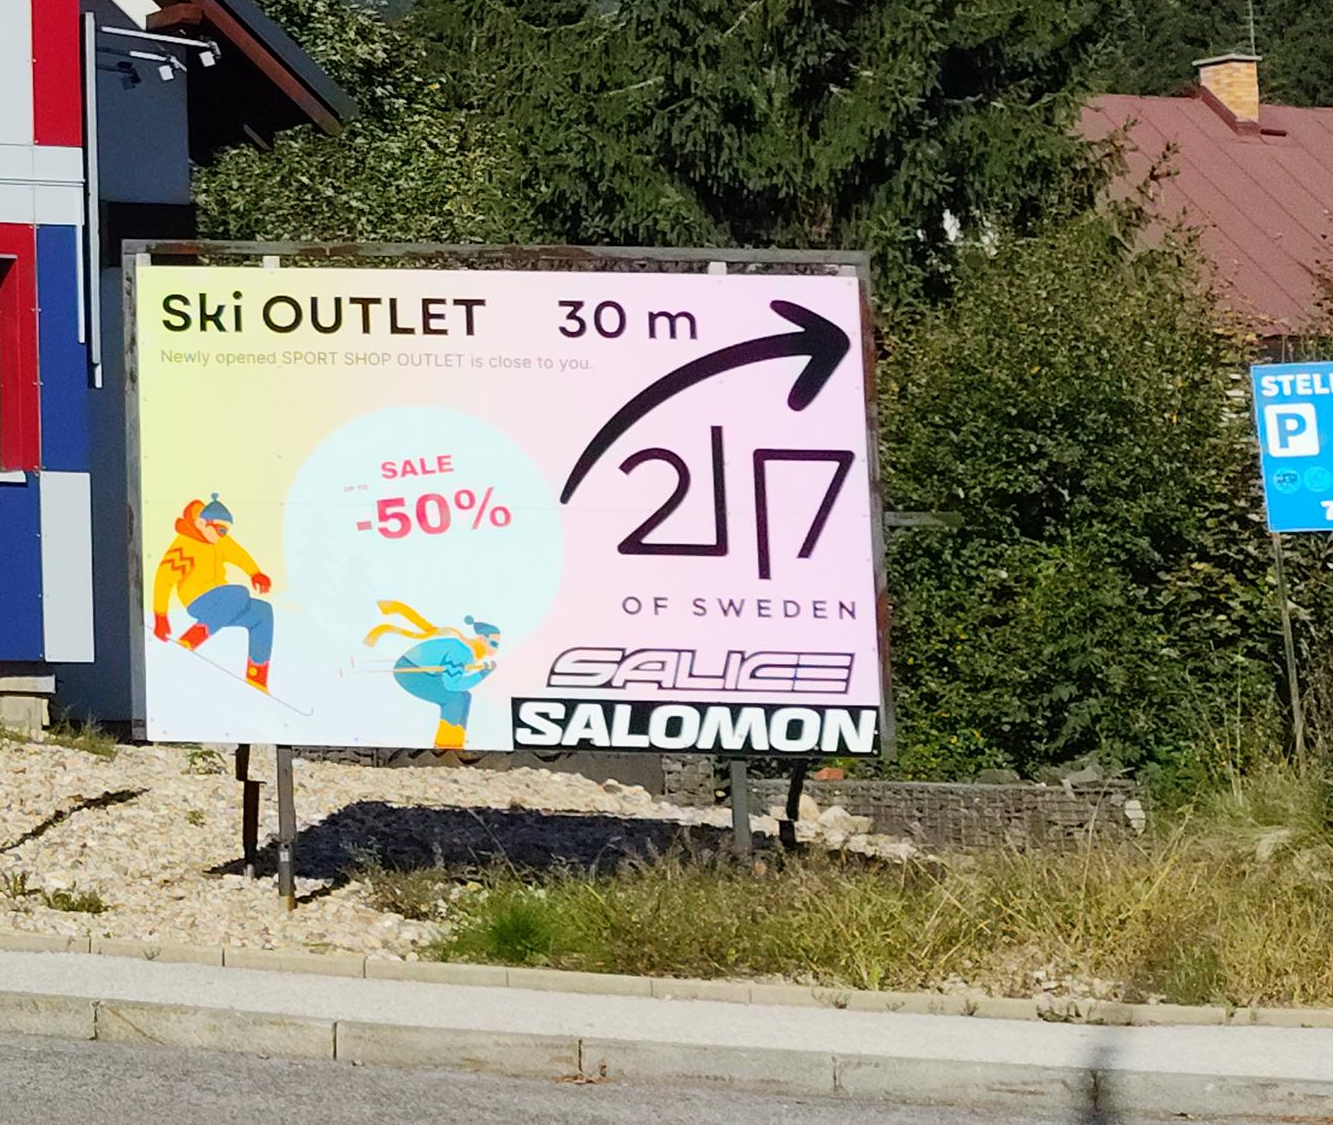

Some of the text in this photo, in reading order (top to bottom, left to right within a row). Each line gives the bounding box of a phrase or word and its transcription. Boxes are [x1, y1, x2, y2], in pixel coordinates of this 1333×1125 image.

[161, 290, 698, 340] Ski OUTLET 30 m
[160, 348, 594, 373] Newly opened SPORT SHOP OUTLET is close to you.
[1261, 373, 1333, 397] STEL
[1275, 412, 1307, 449] P
[381, 454, 454, 479] SALE
[356, 486, 512, 539] -50%
[622, 596, 857, 620] OF SWEDEN
[546, 646, 856, 694] SALICE
[515, 701, 877, 753] SALOMON
